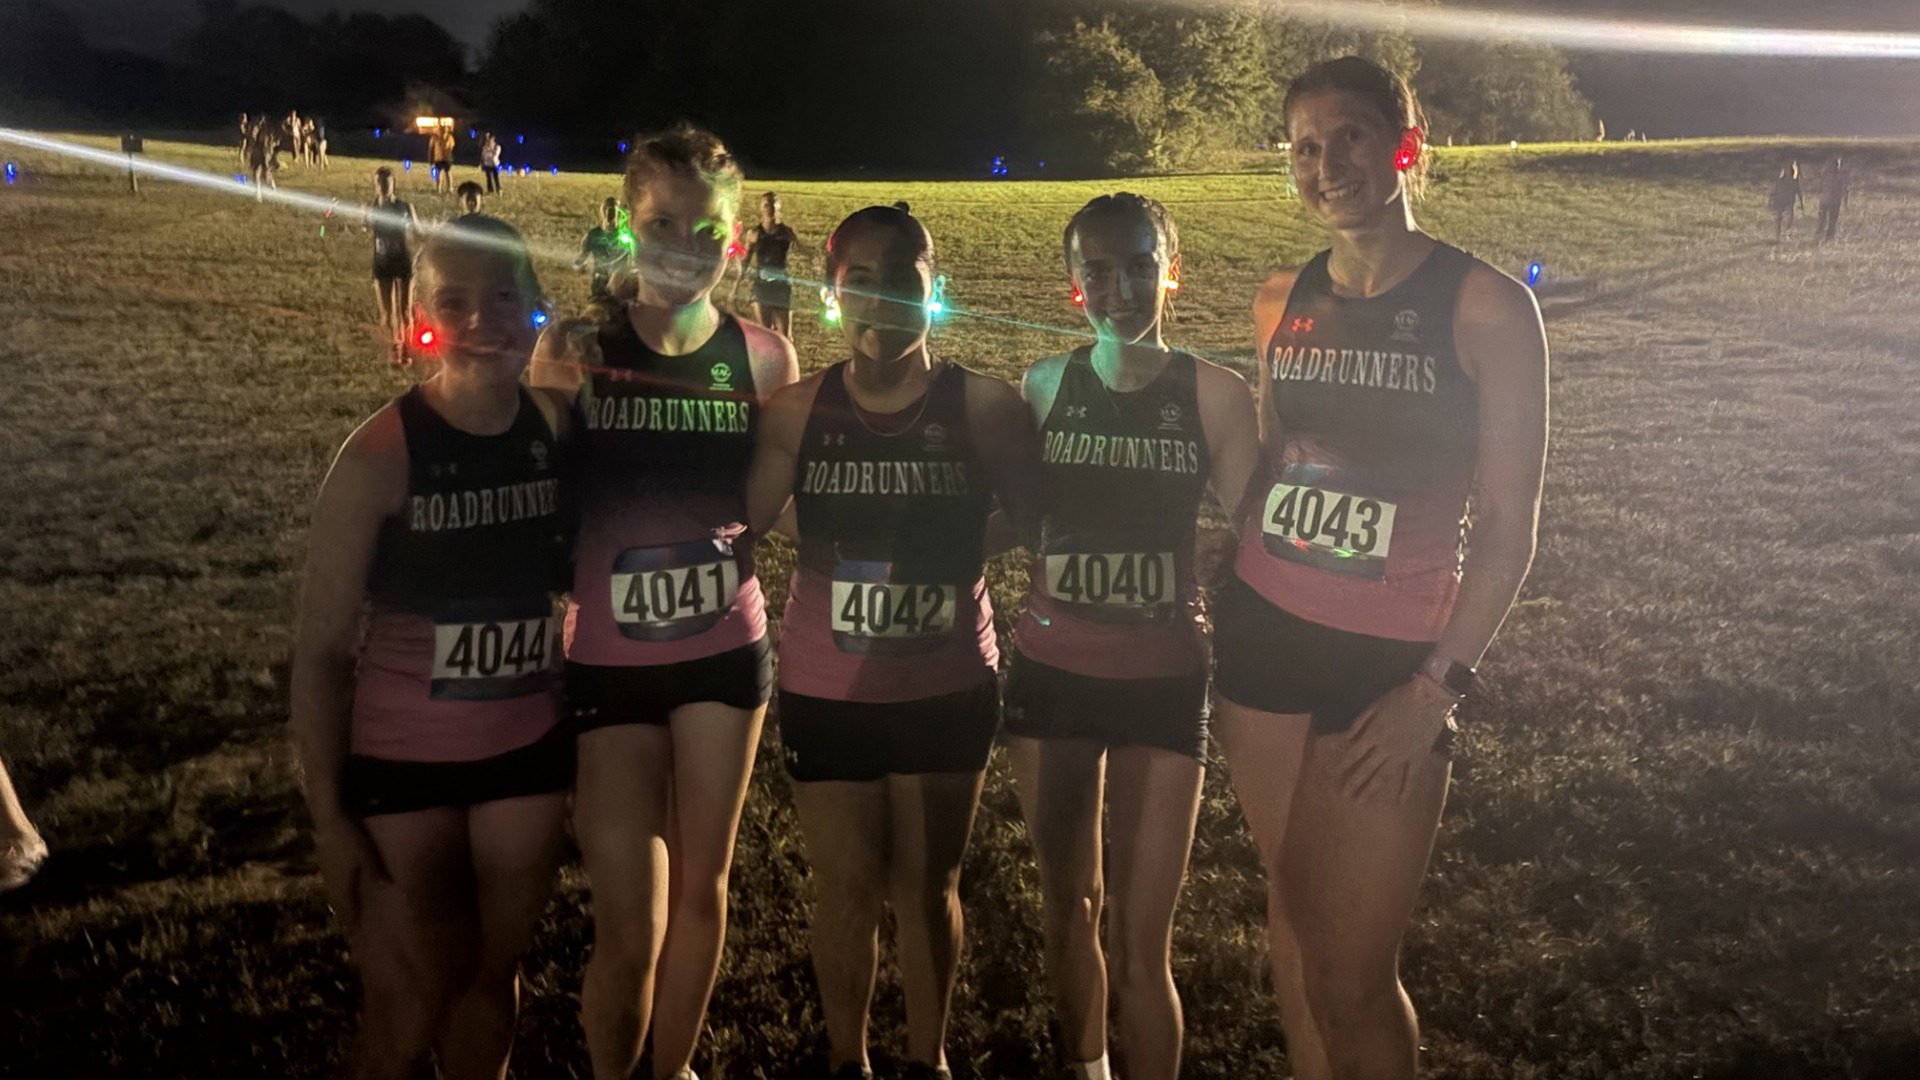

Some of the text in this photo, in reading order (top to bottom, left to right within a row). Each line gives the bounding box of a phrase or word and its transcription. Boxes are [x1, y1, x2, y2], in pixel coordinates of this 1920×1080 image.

[1272, 345, 1436, 394] ROADRUNNERS
[586, 397, 749, 433] ROADRUNNERS
[1042, 430, 1198, 474] ROADRUNNERS
[802, 460, 969, 495] ROADRUNNERS
[1271, 487, 1381, 553] 4043
[623, 563, 725, 620] 4041
[1056, 553, 1164, 603] 4040
[841, 584, 945, 633] 4042
[446, 619, 546, 676] 4044
